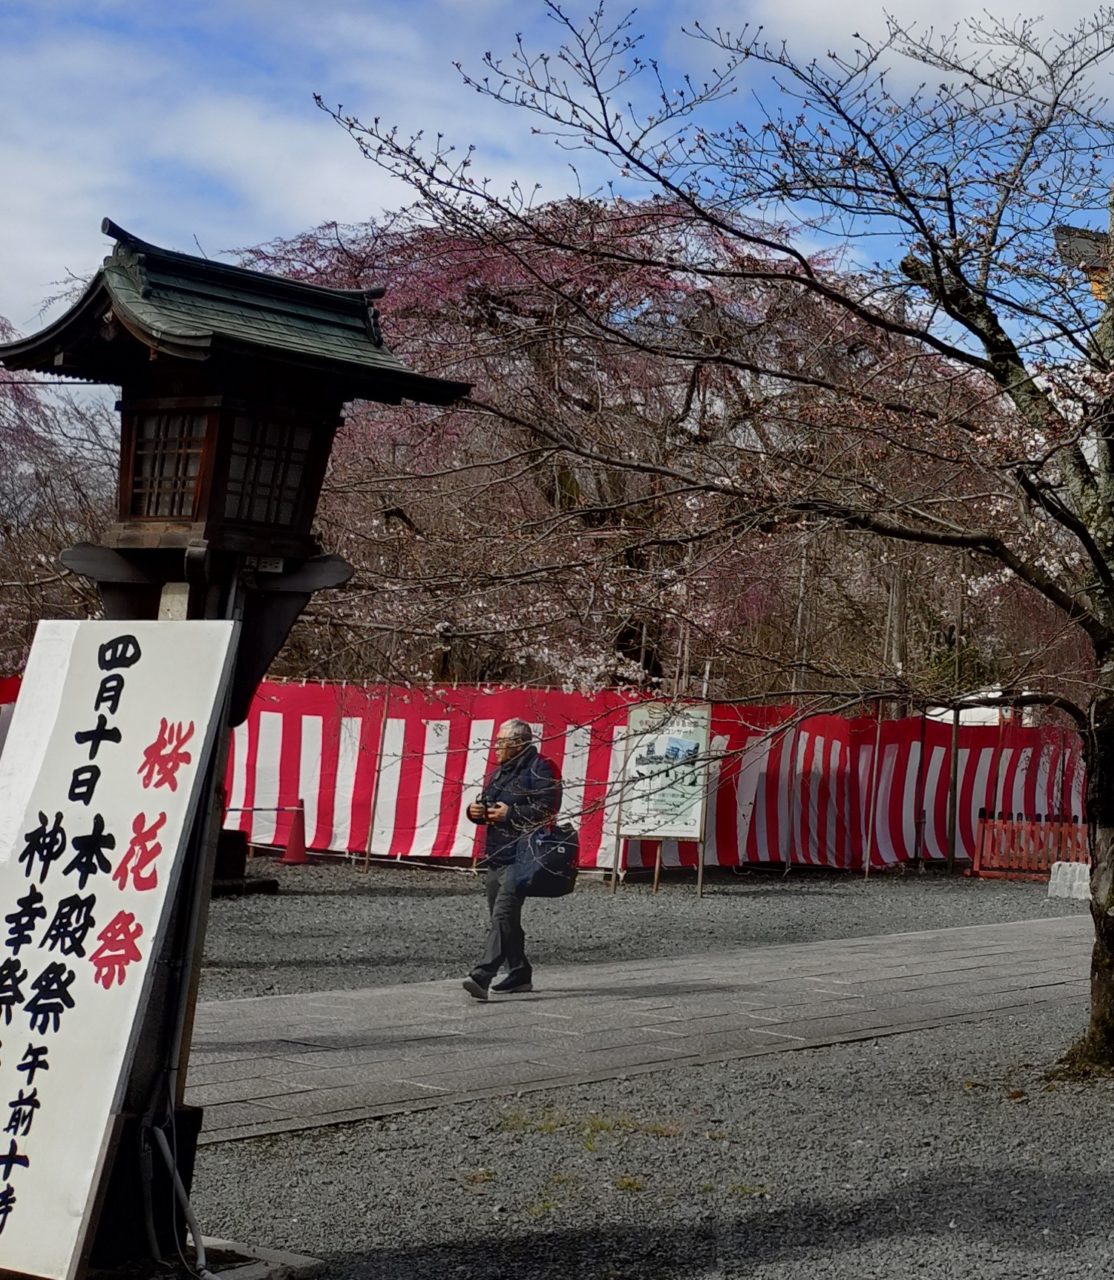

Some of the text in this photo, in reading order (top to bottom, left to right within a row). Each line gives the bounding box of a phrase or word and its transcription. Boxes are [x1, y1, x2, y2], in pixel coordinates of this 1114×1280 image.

[68, 635, 141, 805] 四月十日
[23, 814, 115, 1034] 本殿祭
[89, 717, 194, 989] 桜花祭
